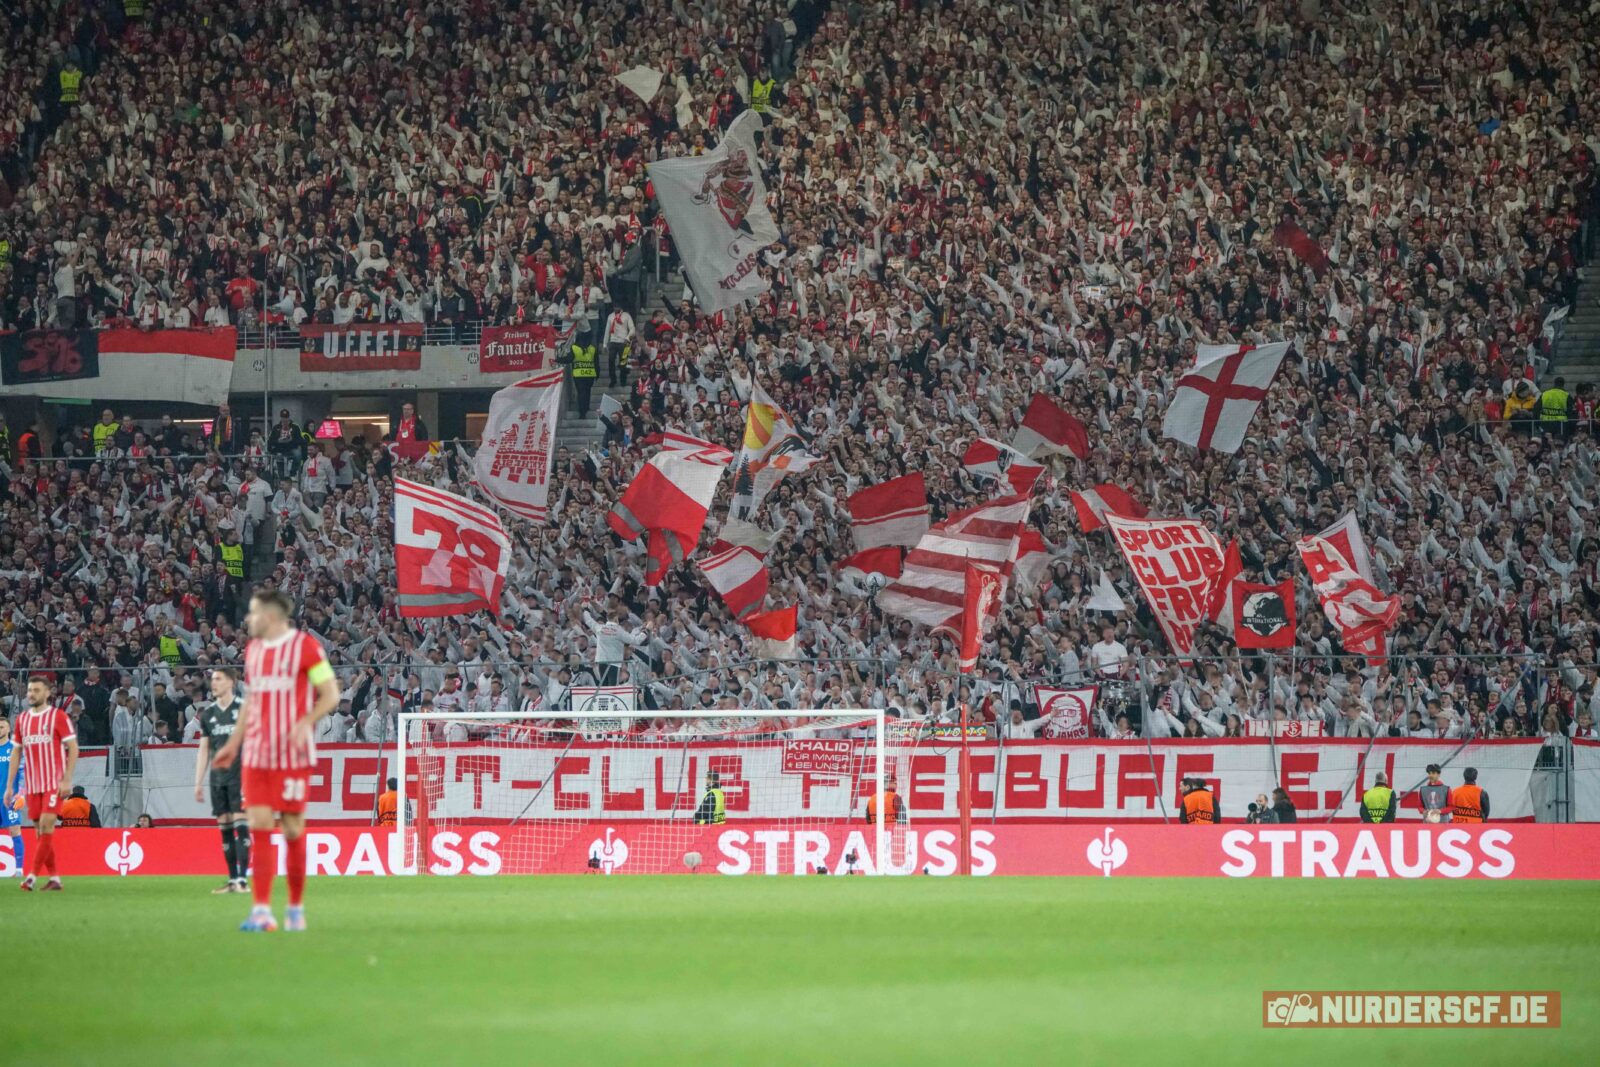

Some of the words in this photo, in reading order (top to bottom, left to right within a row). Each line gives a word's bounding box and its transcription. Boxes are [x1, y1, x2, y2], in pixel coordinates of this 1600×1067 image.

[503, 331, 530, 340] Freiburg
[484, 339, 546, 358] Fanatics
[1117, 524, 1205, 553] SPORT
[1131, 546, 1223, 586] CLUB
[1057, 727, 1086, 739] JAHRE
[788, 742, 850, 752] KHALID
[787, 752, 810, 760] FÜR
[812, 754, 849, 762] IMMER
[816, 763, 840, 771] UNS
[48, 794, 57, 808] 5
[271, 832, 501, 876] TRAUSS
[717, 829, 997, 877] STRAUSS
[1220, 828, 1516, 879] STRAUSS
